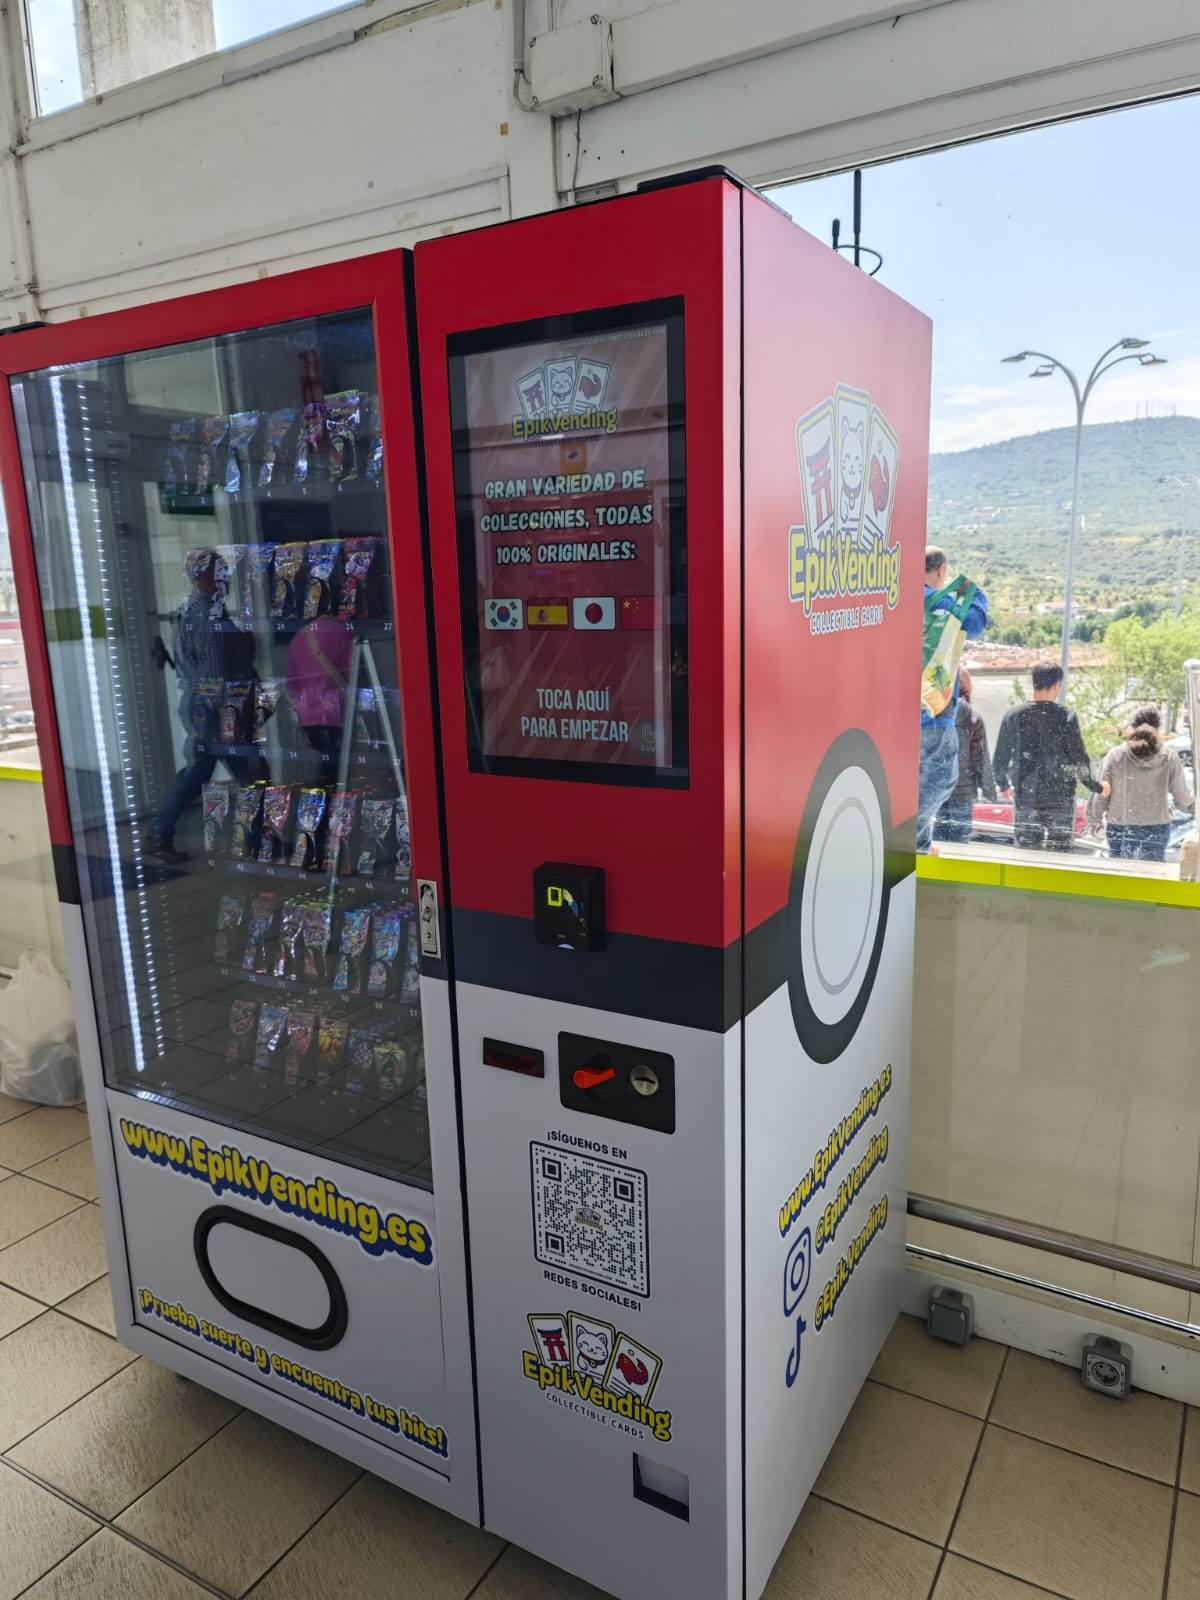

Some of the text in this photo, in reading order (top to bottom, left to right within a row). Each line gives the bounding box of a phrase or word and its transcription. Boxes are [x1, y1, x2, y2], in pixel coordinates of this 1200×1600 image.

[512, 407, 618, 441] EpikVending
[484, 469, 645, 500] GRAN VARIEDAD DE
[480, 504, 653, 532] COLECCIONES, TODAS
[496, 541, 636, 564] 100% ORIGINALES:
[789, 525, 901, 616] EpikVending
[810, 604, 883, 635] COLLECTIBLE CARDS
[536, 686, 610, 712] TOCA AQUÍ
[521, 716, 629, 742] PARA EMPEZAR
[547, 1130, 627, 1160] ¡SÍGUENOS EN
[778, 1064, 892, 1237] www.EpikVending.es
[120, 1117, 434, 1266] www.EpikVending.es
[815, 1126, 888, 1253] @EpikVending
[543, 1269, 578, 1290] REDES
[581, 1283, 641, 1312] SOCIALES!
[139, 1288, 448, 1458] ¡Prueba suerte y encuentra tus hits!
[523, 1350, 672, 1442] EpikVending
[546, 1392, 645, 1440] COLLECTIBLE CARDS
